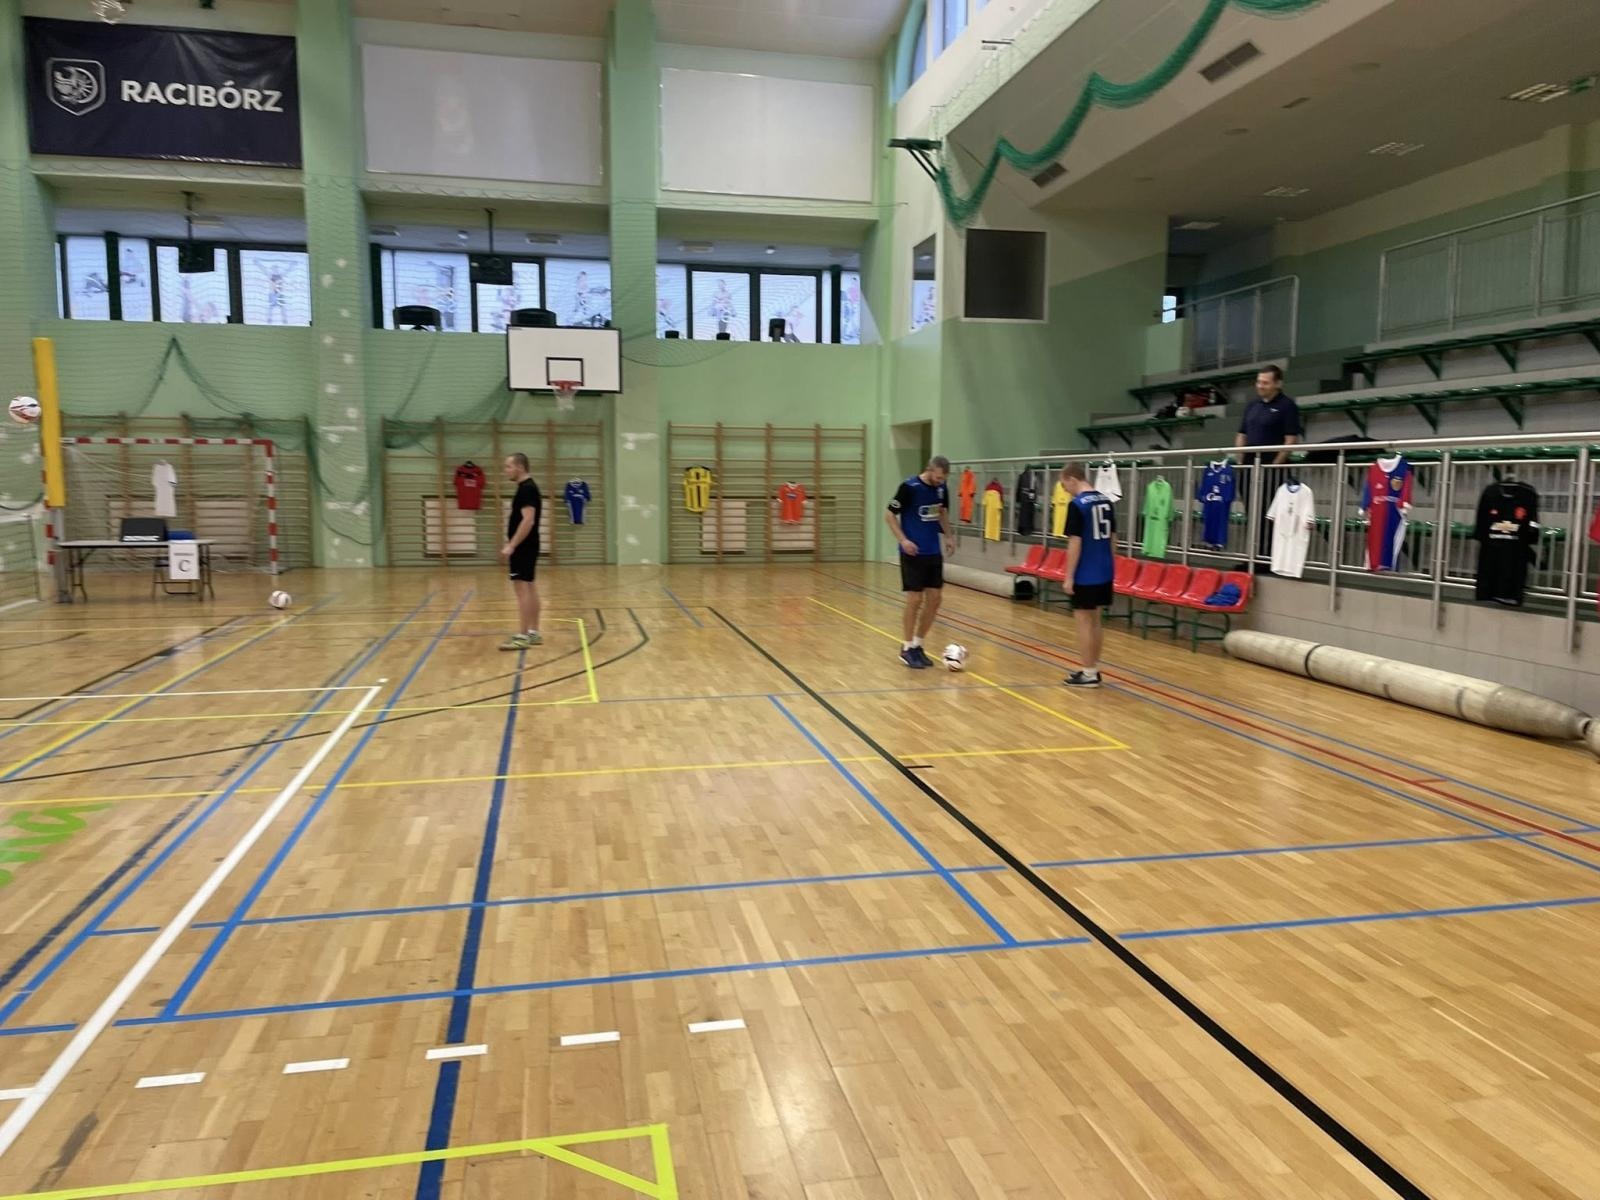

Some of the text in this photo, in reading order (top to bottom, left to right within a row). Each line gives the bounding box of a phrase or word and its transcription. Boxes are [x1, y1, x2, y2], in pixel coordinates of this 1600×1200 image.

[120, 79, 284, 113] RACIBÓRZ
[1091, 502, 1112, 540] 15
[178, 559, 192, 573] C
